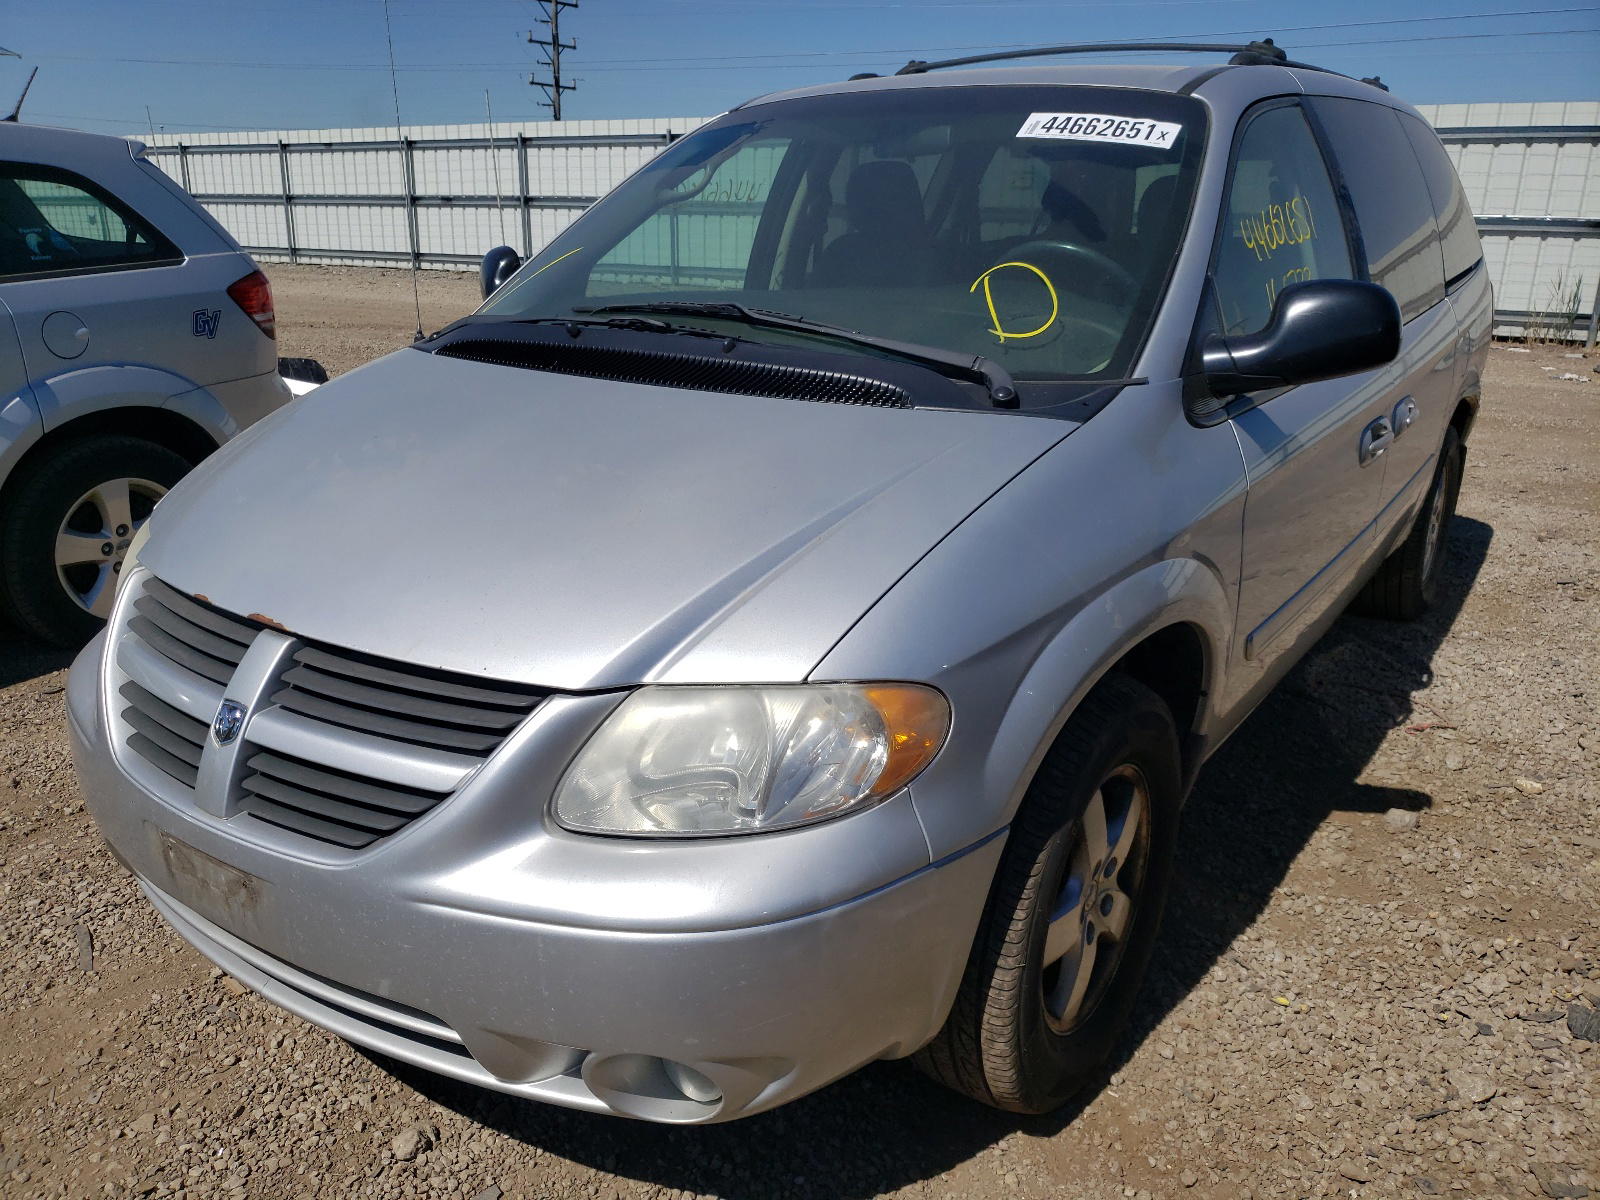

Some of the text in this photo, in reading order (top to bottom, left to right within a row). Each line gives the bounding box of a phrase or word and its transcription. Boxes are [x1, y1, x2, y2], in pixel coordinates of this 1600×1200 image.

[1041, 116, 1157, 141] 44662651
[969, 261, 1058, 344] D
[192, 308, 222, 339] GV
